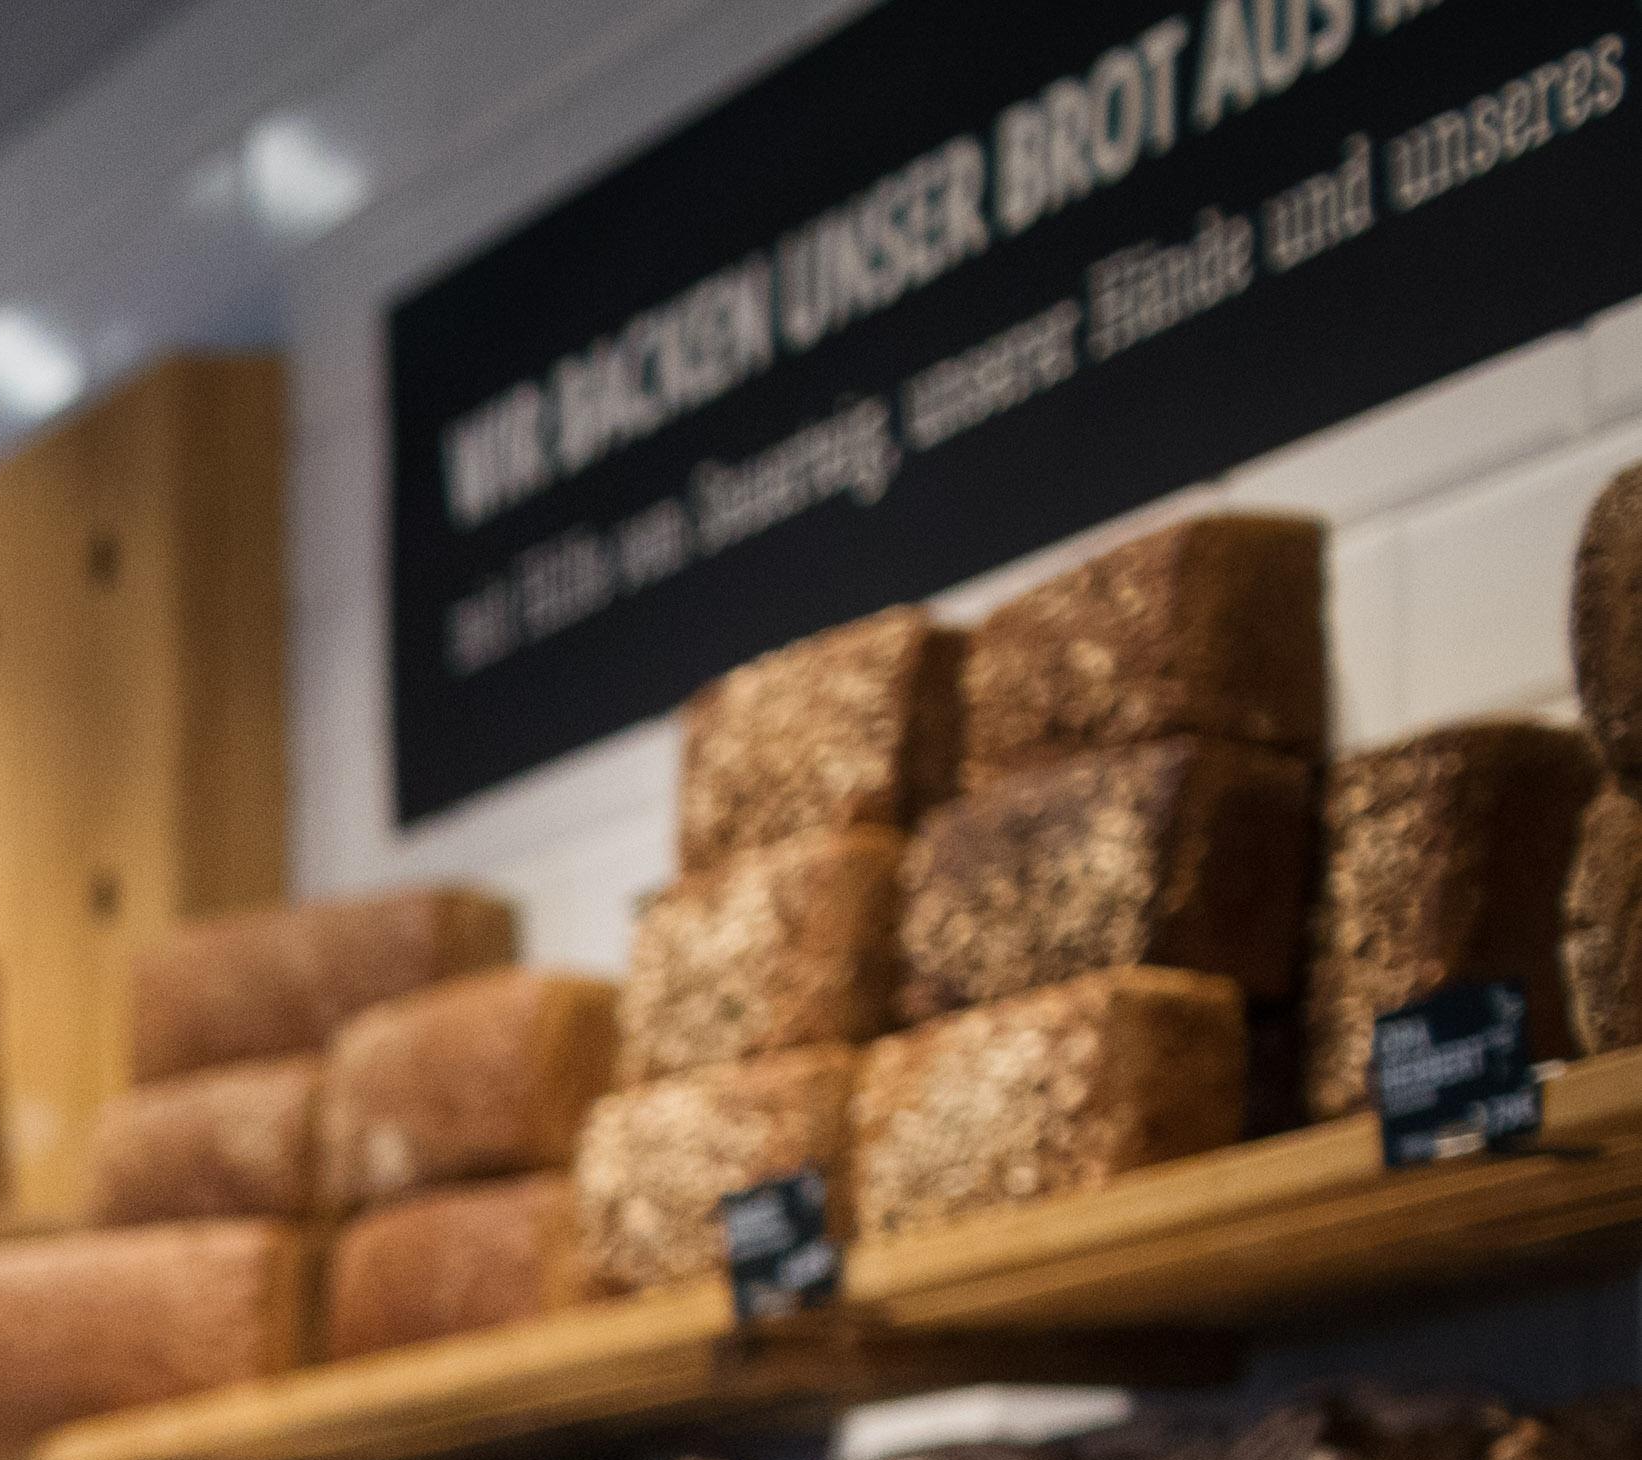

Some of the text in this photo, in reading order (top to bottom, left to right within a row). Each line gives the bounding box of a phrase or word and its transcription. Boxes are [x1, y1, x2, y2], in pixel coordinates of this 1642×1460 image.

[778, 134, 987, 352] UNSER
[995, 14, 1189, 237] BROT
[1263, 131, 1375, 272] und
[1386, 32, 1626, 211] unseres
